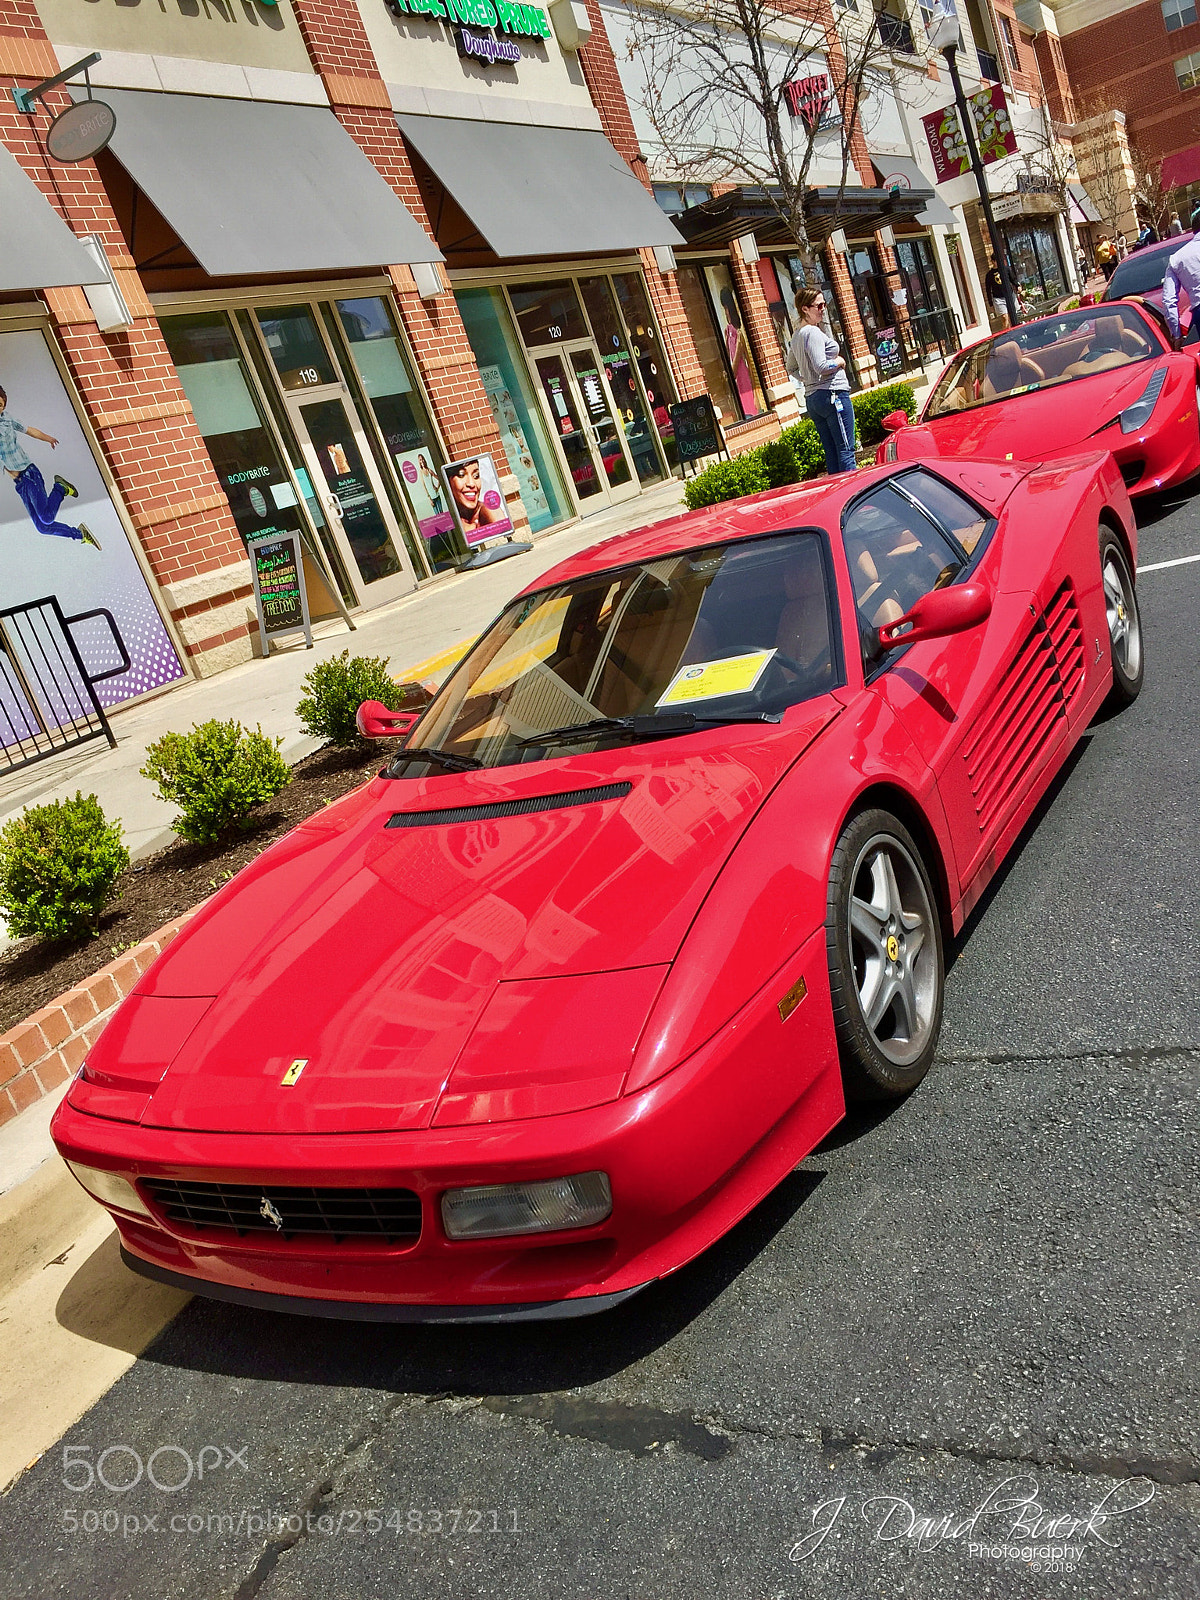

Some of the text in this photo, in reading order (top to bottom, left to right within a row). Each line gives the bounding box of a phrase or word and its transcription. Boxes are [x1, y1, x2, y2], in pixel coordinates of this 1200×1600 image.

[499, 0, 552, 41] PRUNE
[460, 28, 521, 64] Doughnuts
[926, 122, 946, 174] WELCOME
[548, 325, 562, 339] 120
[299, 368, 318, 384] 119
[266, 599, 296, 617] FREE DEMO
